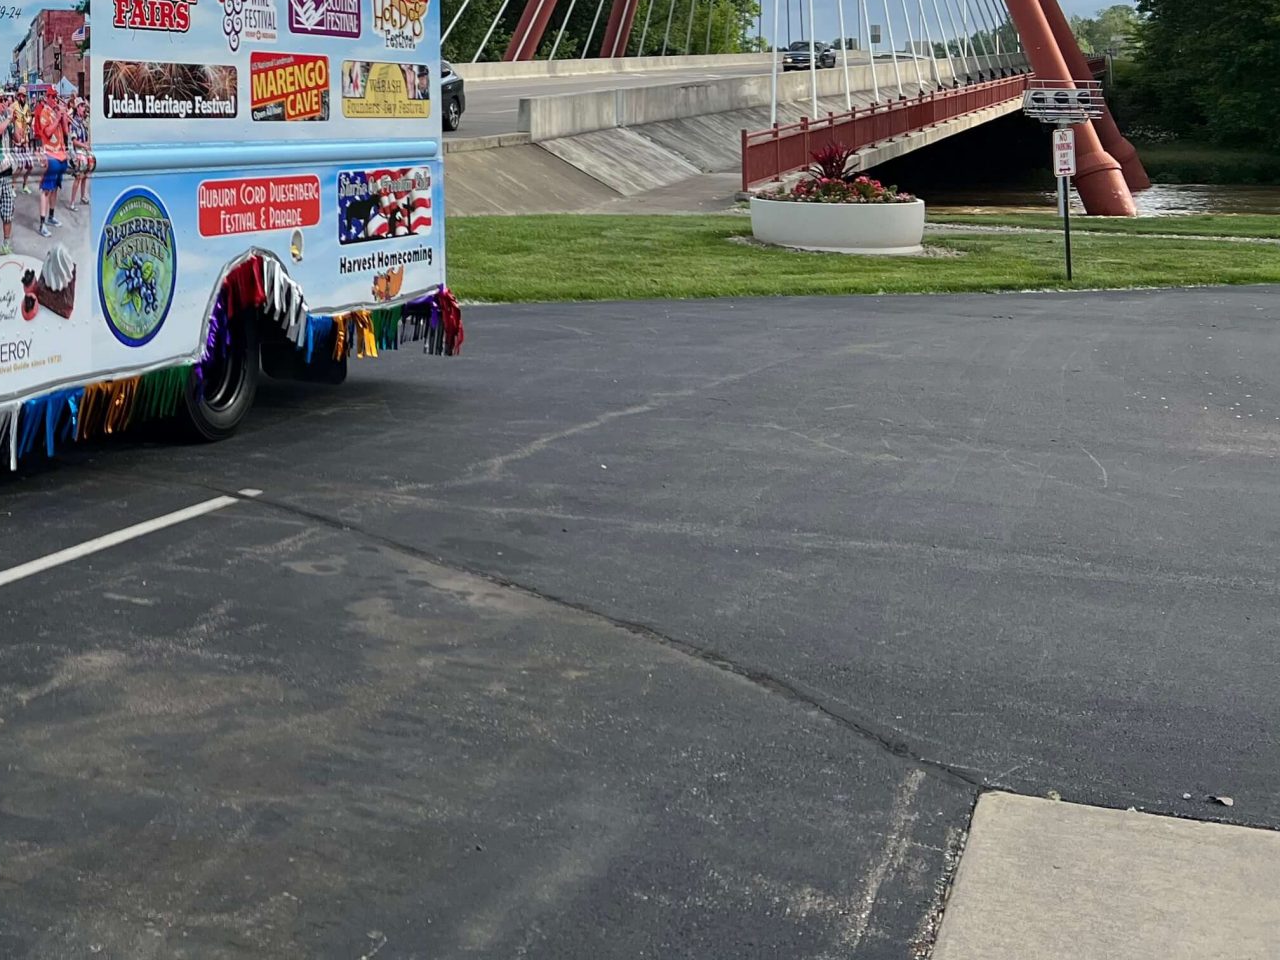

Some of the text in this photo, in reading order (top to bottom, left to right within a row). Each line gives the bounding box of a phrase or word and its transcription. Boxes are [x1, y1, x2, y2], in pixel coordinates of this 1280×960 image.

[244, 9, 276, 30] FESTIVAL
[326, 12, 359, 33] FESTIVAL
[252, 60, 326, 101] MARENGO
[369, 79, 401, 93] WABASH
[108, 95, 234, 120] Judah Heritage Festival
[287, 89, 319, 116] CAVE
[1056, 143, 1072, 151] PARKING
[1059, 134, 1067, 142] NO
[200, 181, 319, 208] AUBURN CORD DUESENBERG
[220, 207, 303, 233] FESTIVAL & PARADE
[105, 218, 170, 255] BLUEBERRY
[113, 238, 164, 268] FESTIVAL
[340, 244, 432, 274] Harvest Homecoming
[13, 362, 30, 373] Guide
[31, 359, 46, 368] since
